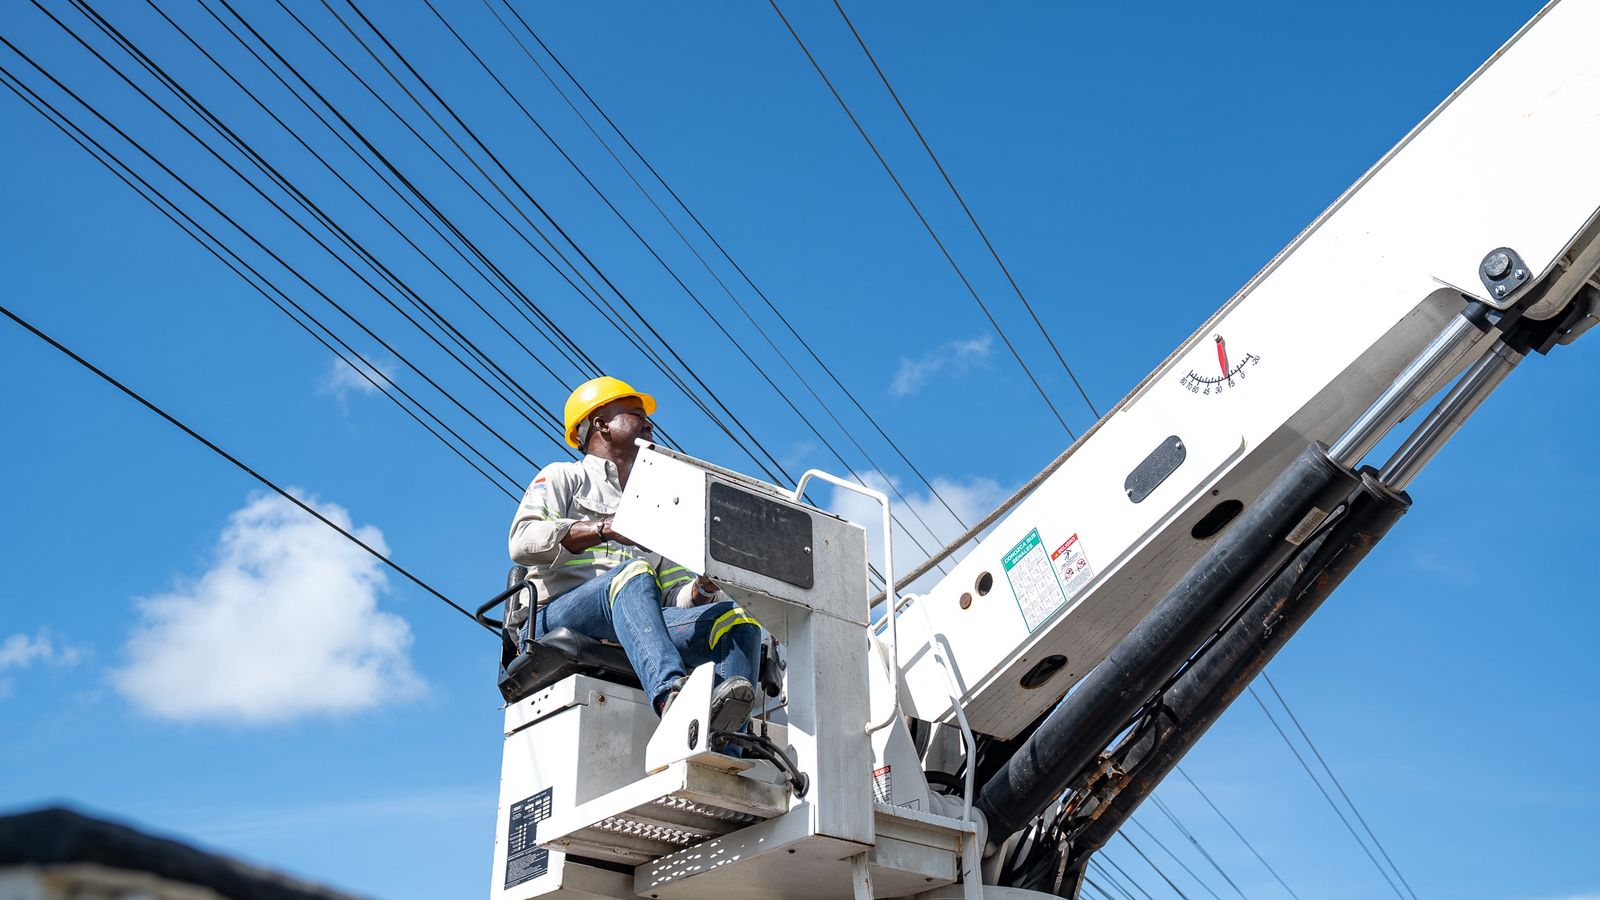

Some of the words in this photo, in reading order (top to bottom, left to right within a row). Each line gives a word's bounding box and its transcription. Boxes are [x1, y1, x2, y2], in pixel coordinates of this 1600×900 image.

[1186, 382, 1193, 391] 70
[1202, 388, 1211, 396] 45
[1004, 542, 1026, 564] CONOZCA
